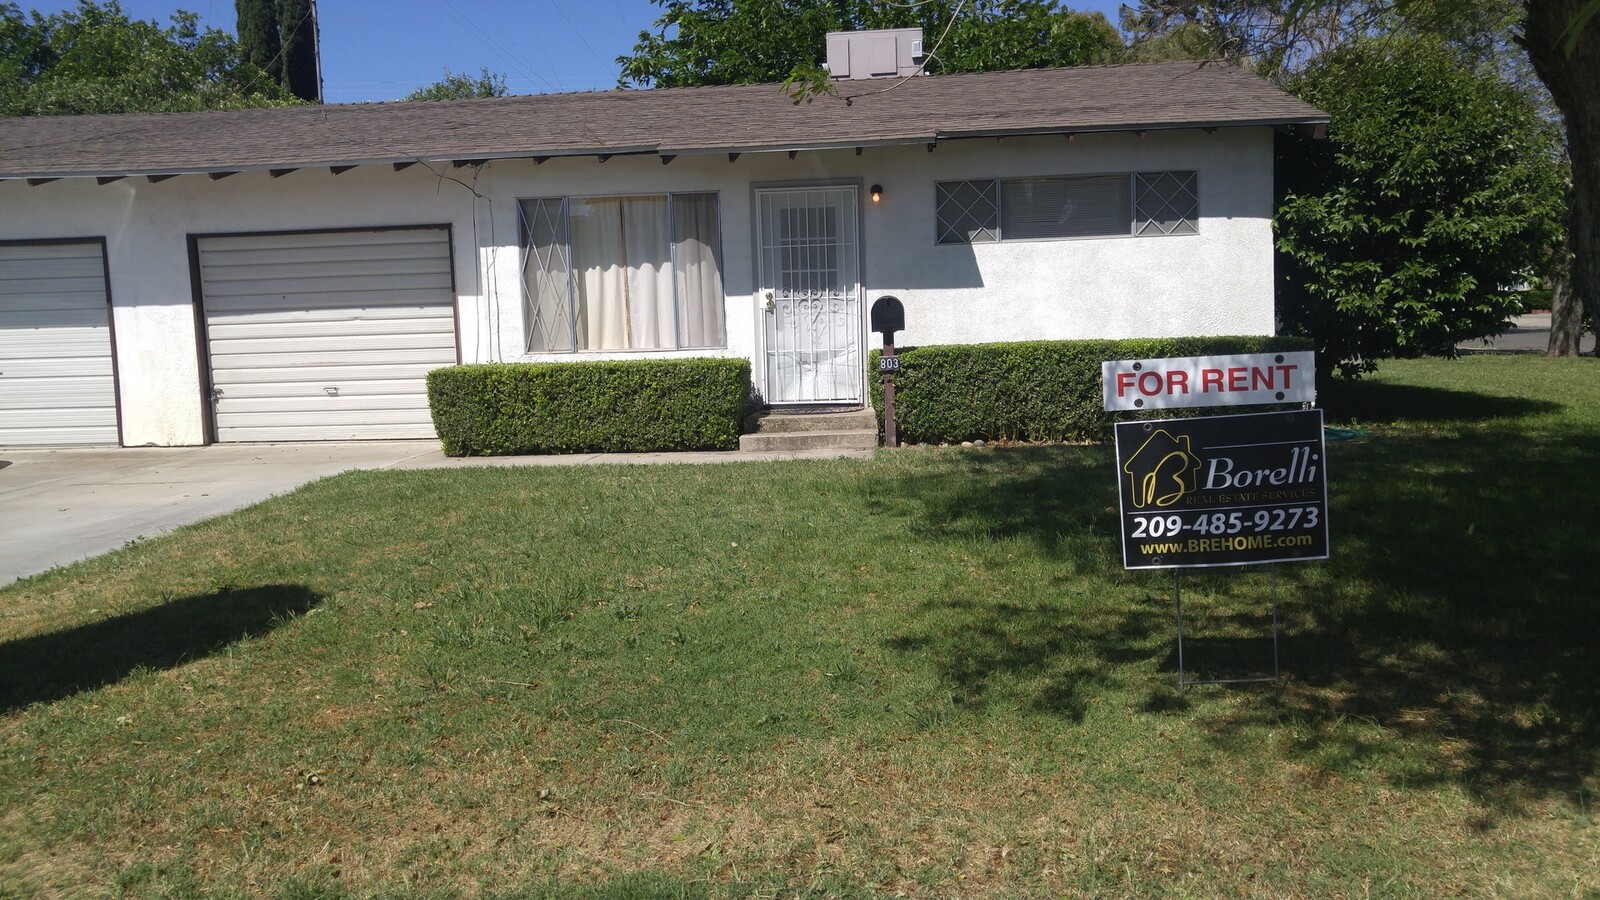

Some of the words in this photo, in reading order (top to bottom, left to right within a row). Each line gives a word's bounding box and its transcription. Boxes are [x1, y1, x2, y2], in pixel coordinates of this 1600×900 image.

[880, 358, 899, 369] 803
[1117, 370, 1189, 397] FOR
[1202, 365, 1297, 393] RENT
[1202, 446, 1319, 490] Borelli
[1186, 496, 1214, 505] REAL
[1218, 492, 1260, 503] ESTATE
[1262, 488, 1316, 499] SERVICES
[1131, 507, 1319, 538] 209-485-9273
[1140, 534, 1312, 555] www.BREHOME.com
